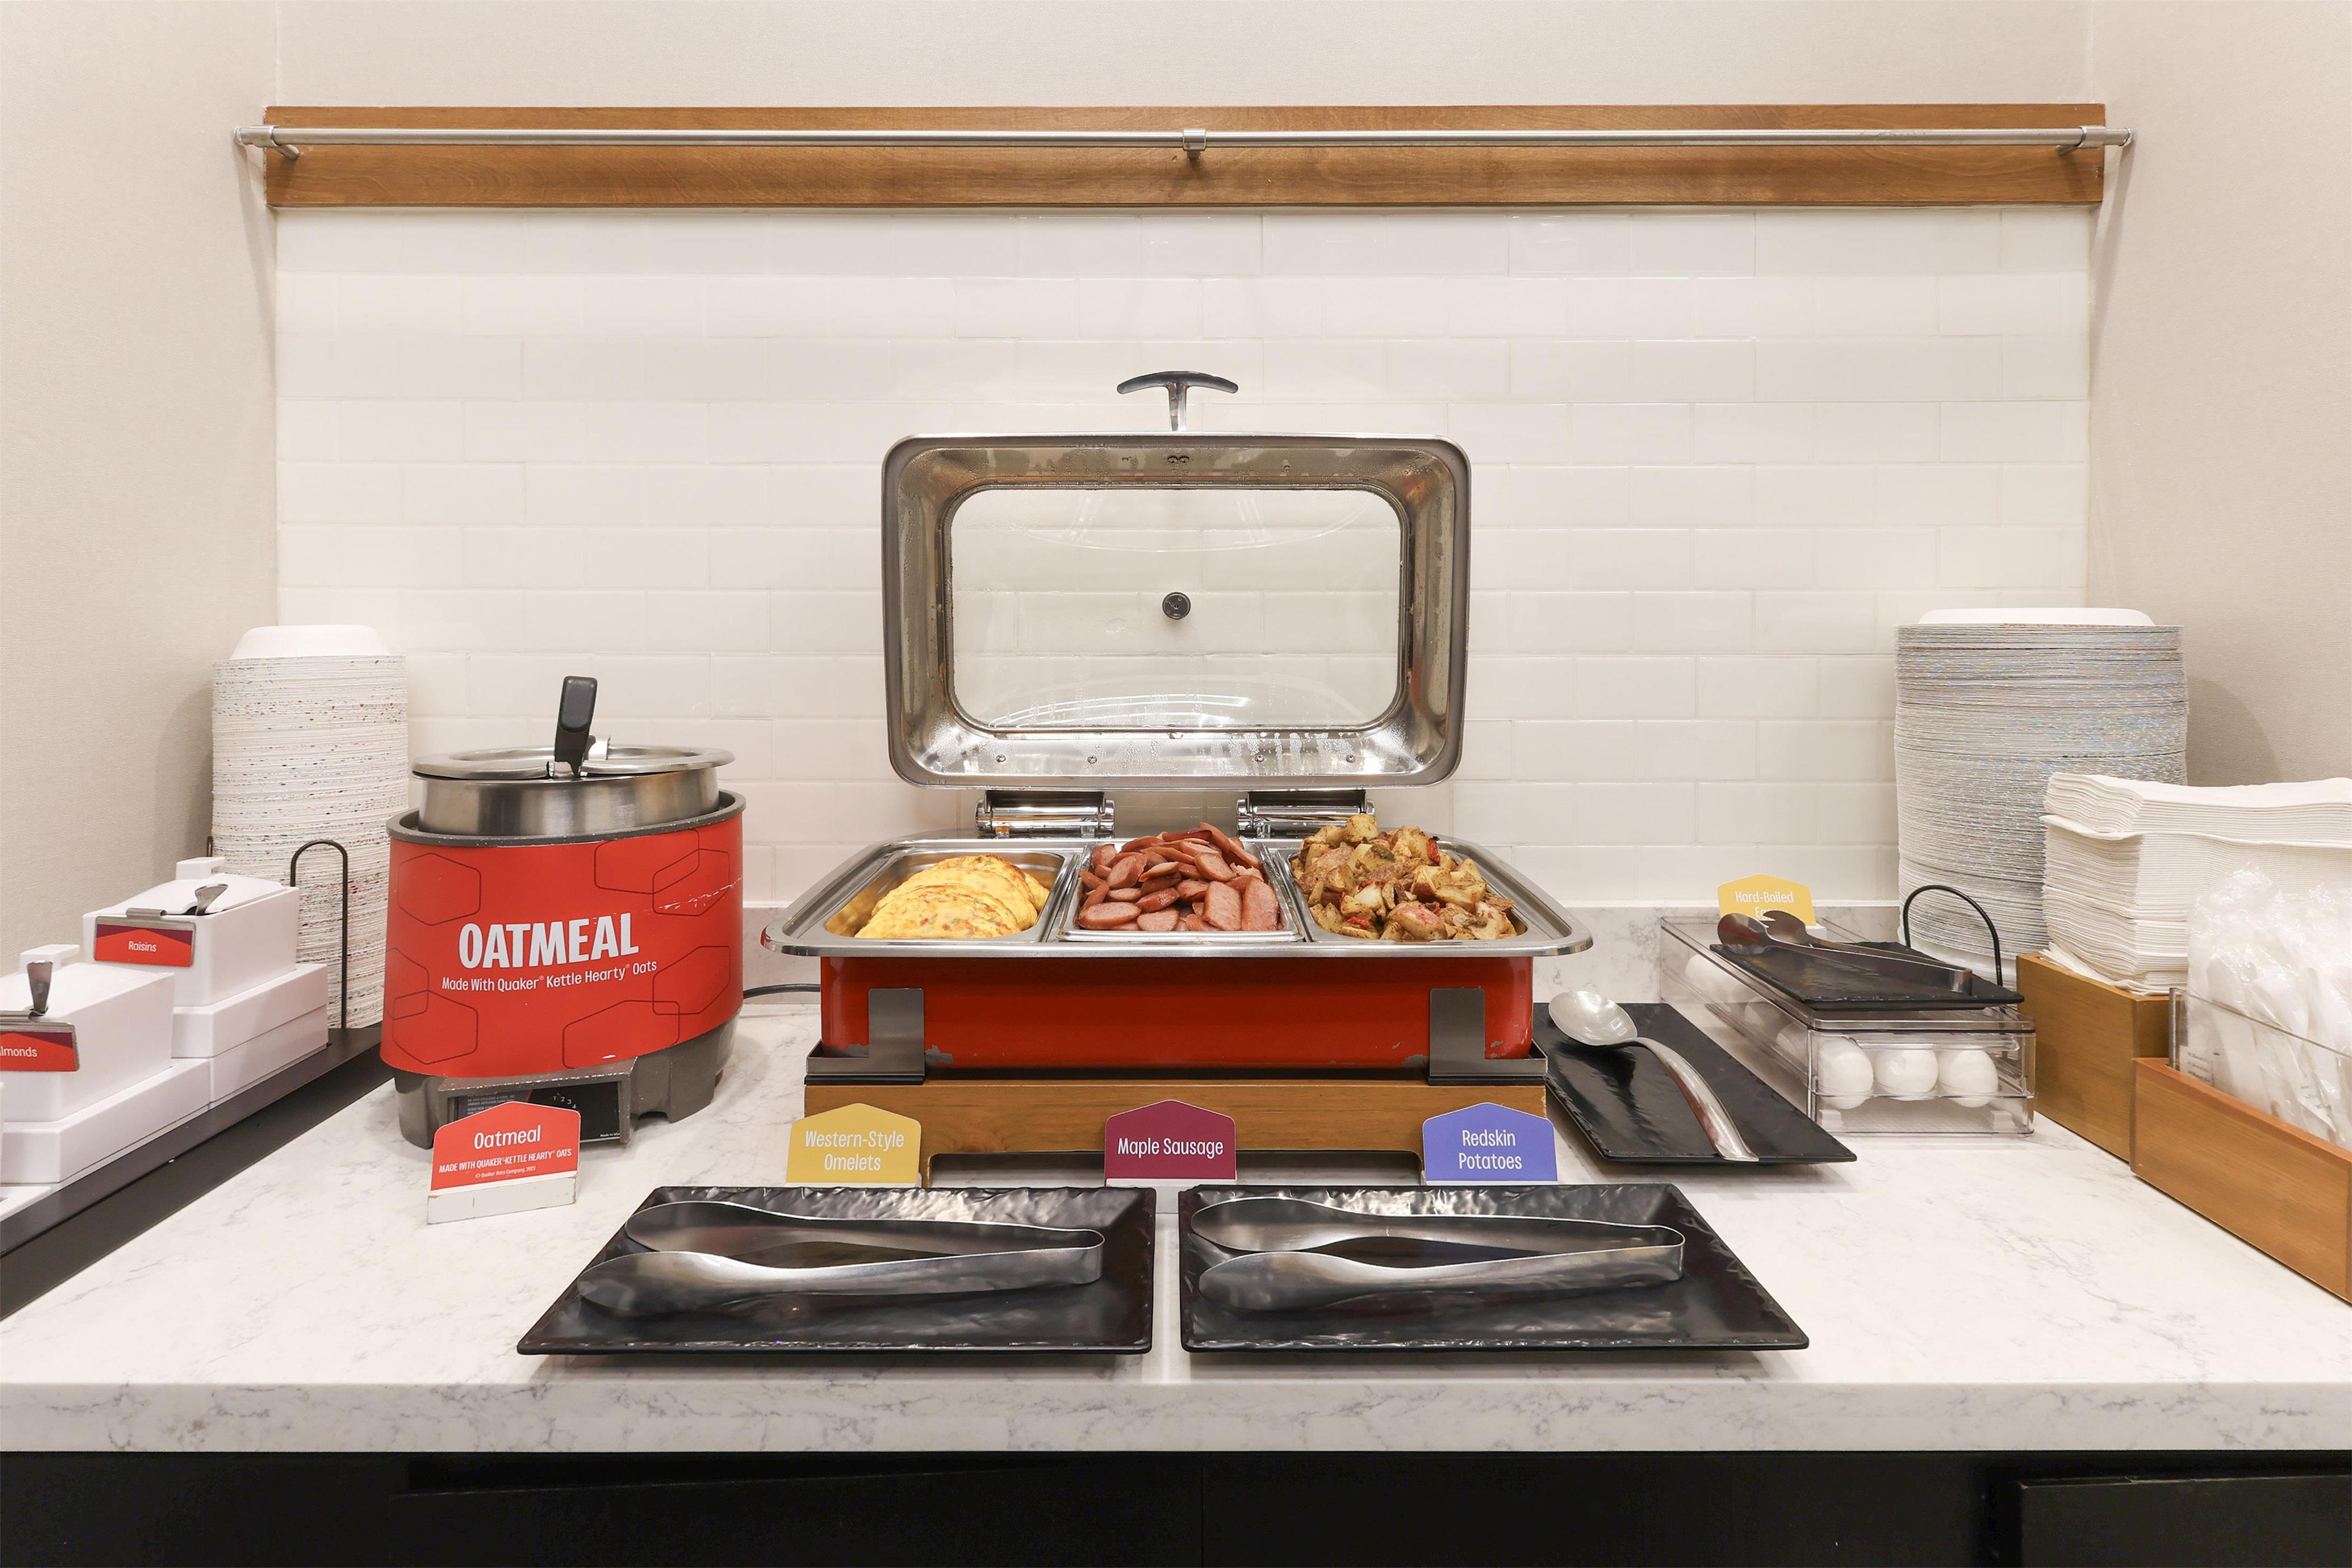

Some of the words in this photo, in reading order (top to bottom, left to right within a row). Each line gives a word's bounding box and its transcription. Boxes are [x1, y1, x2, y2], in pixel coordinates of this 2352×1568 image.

[1735, 891, 1795, 903] Hard-Boiled
[128, 941, 157, 952] Raisins
[459, 912, 639, 969] OATMEAL
[442, 977, 469, 991] Made
[471, 978, 494, 991] With
[546, 972, 582, 988] Kettle
[632, 960, 657, 975] Oats
[474, 1124, 541, 1149] Oatmeal
[805, 1130, 905, 1152] Western-Style
[1462, 1129, 1516, 1147] Redskin
[1117, 1137, 1160, 1159] Maple
[1163, 1137, 1224, 1160] Sausage
[438, 1163, 458, 1173] MADE
[459, 1161, 475, 1171] WITH
[556, 1148, 572, 1158] OATS
[824, 1153, 881, 1171] Omelets
[1458, 1153, 1523, 1170] Potatoes
